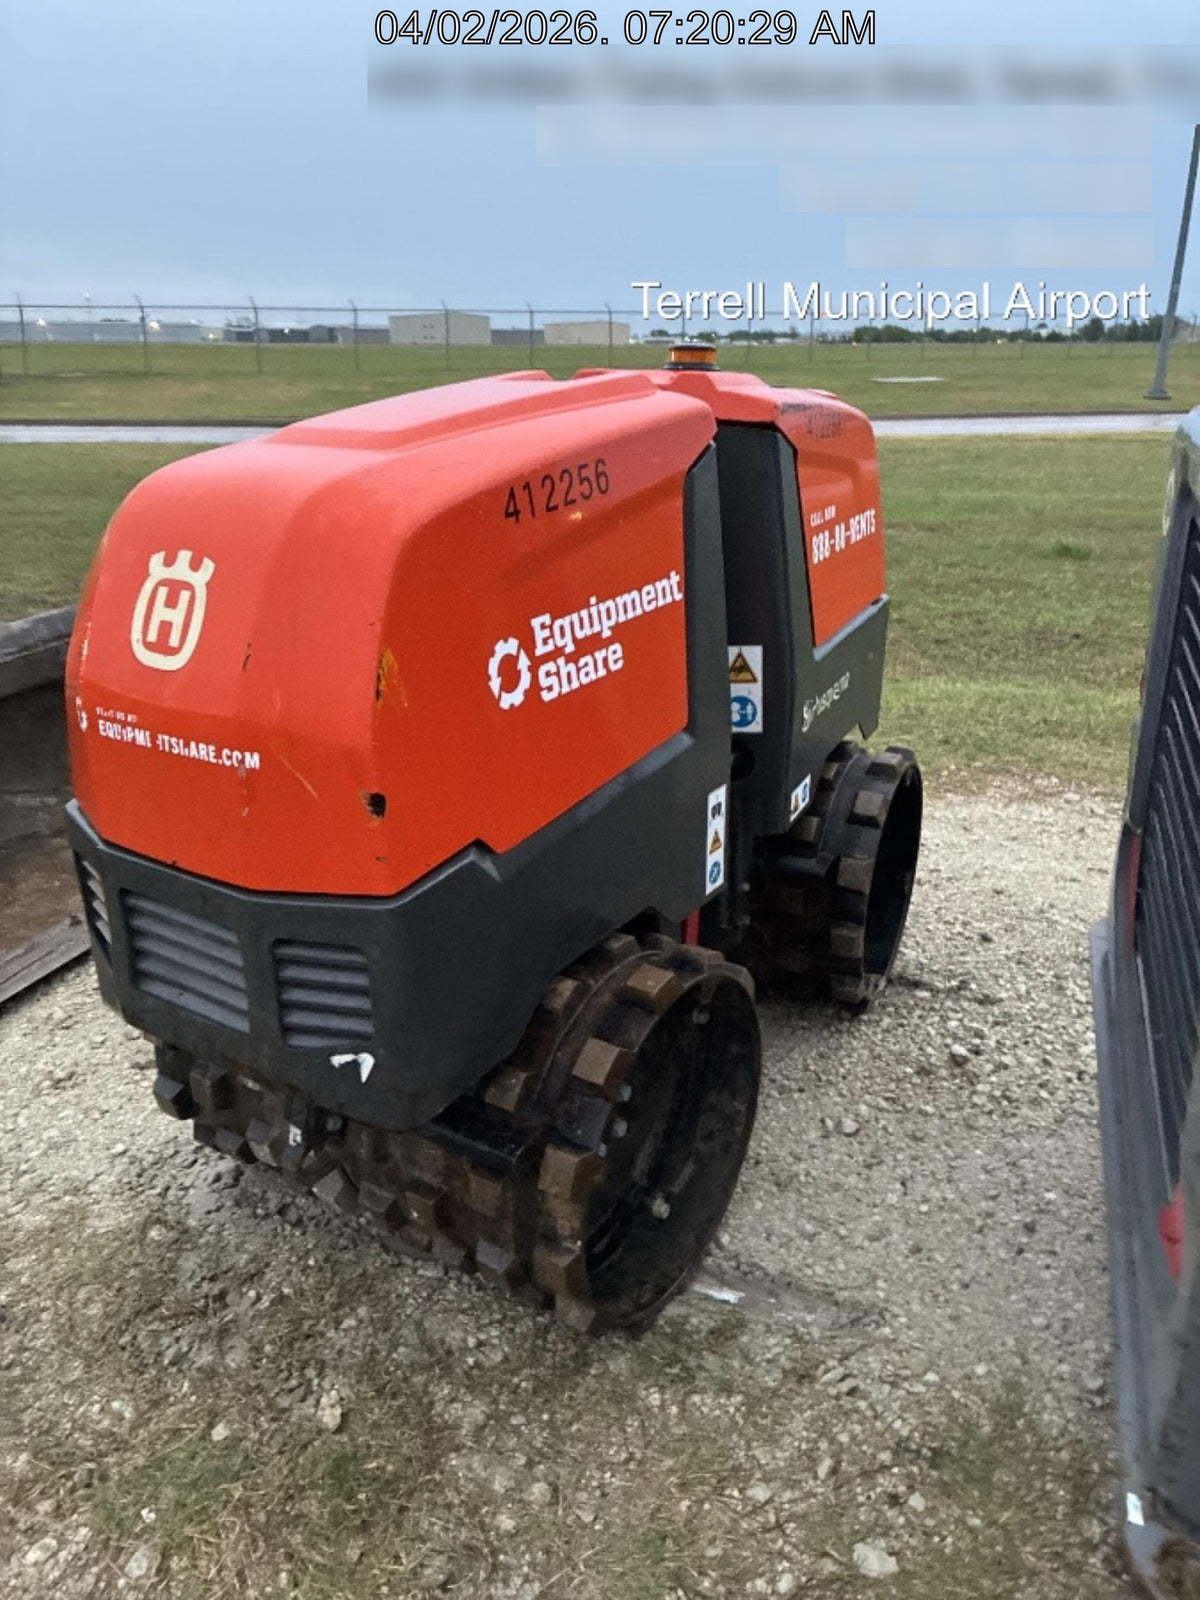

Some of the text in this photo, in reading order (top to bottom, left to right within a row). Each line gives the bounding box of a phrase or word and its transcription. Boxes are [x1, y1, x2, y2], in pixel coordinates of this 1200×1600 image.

[504, 458, 610, 524] 412256
[530, 570, 684, 657] Equipment
[538, 641, 624, 703] Share
